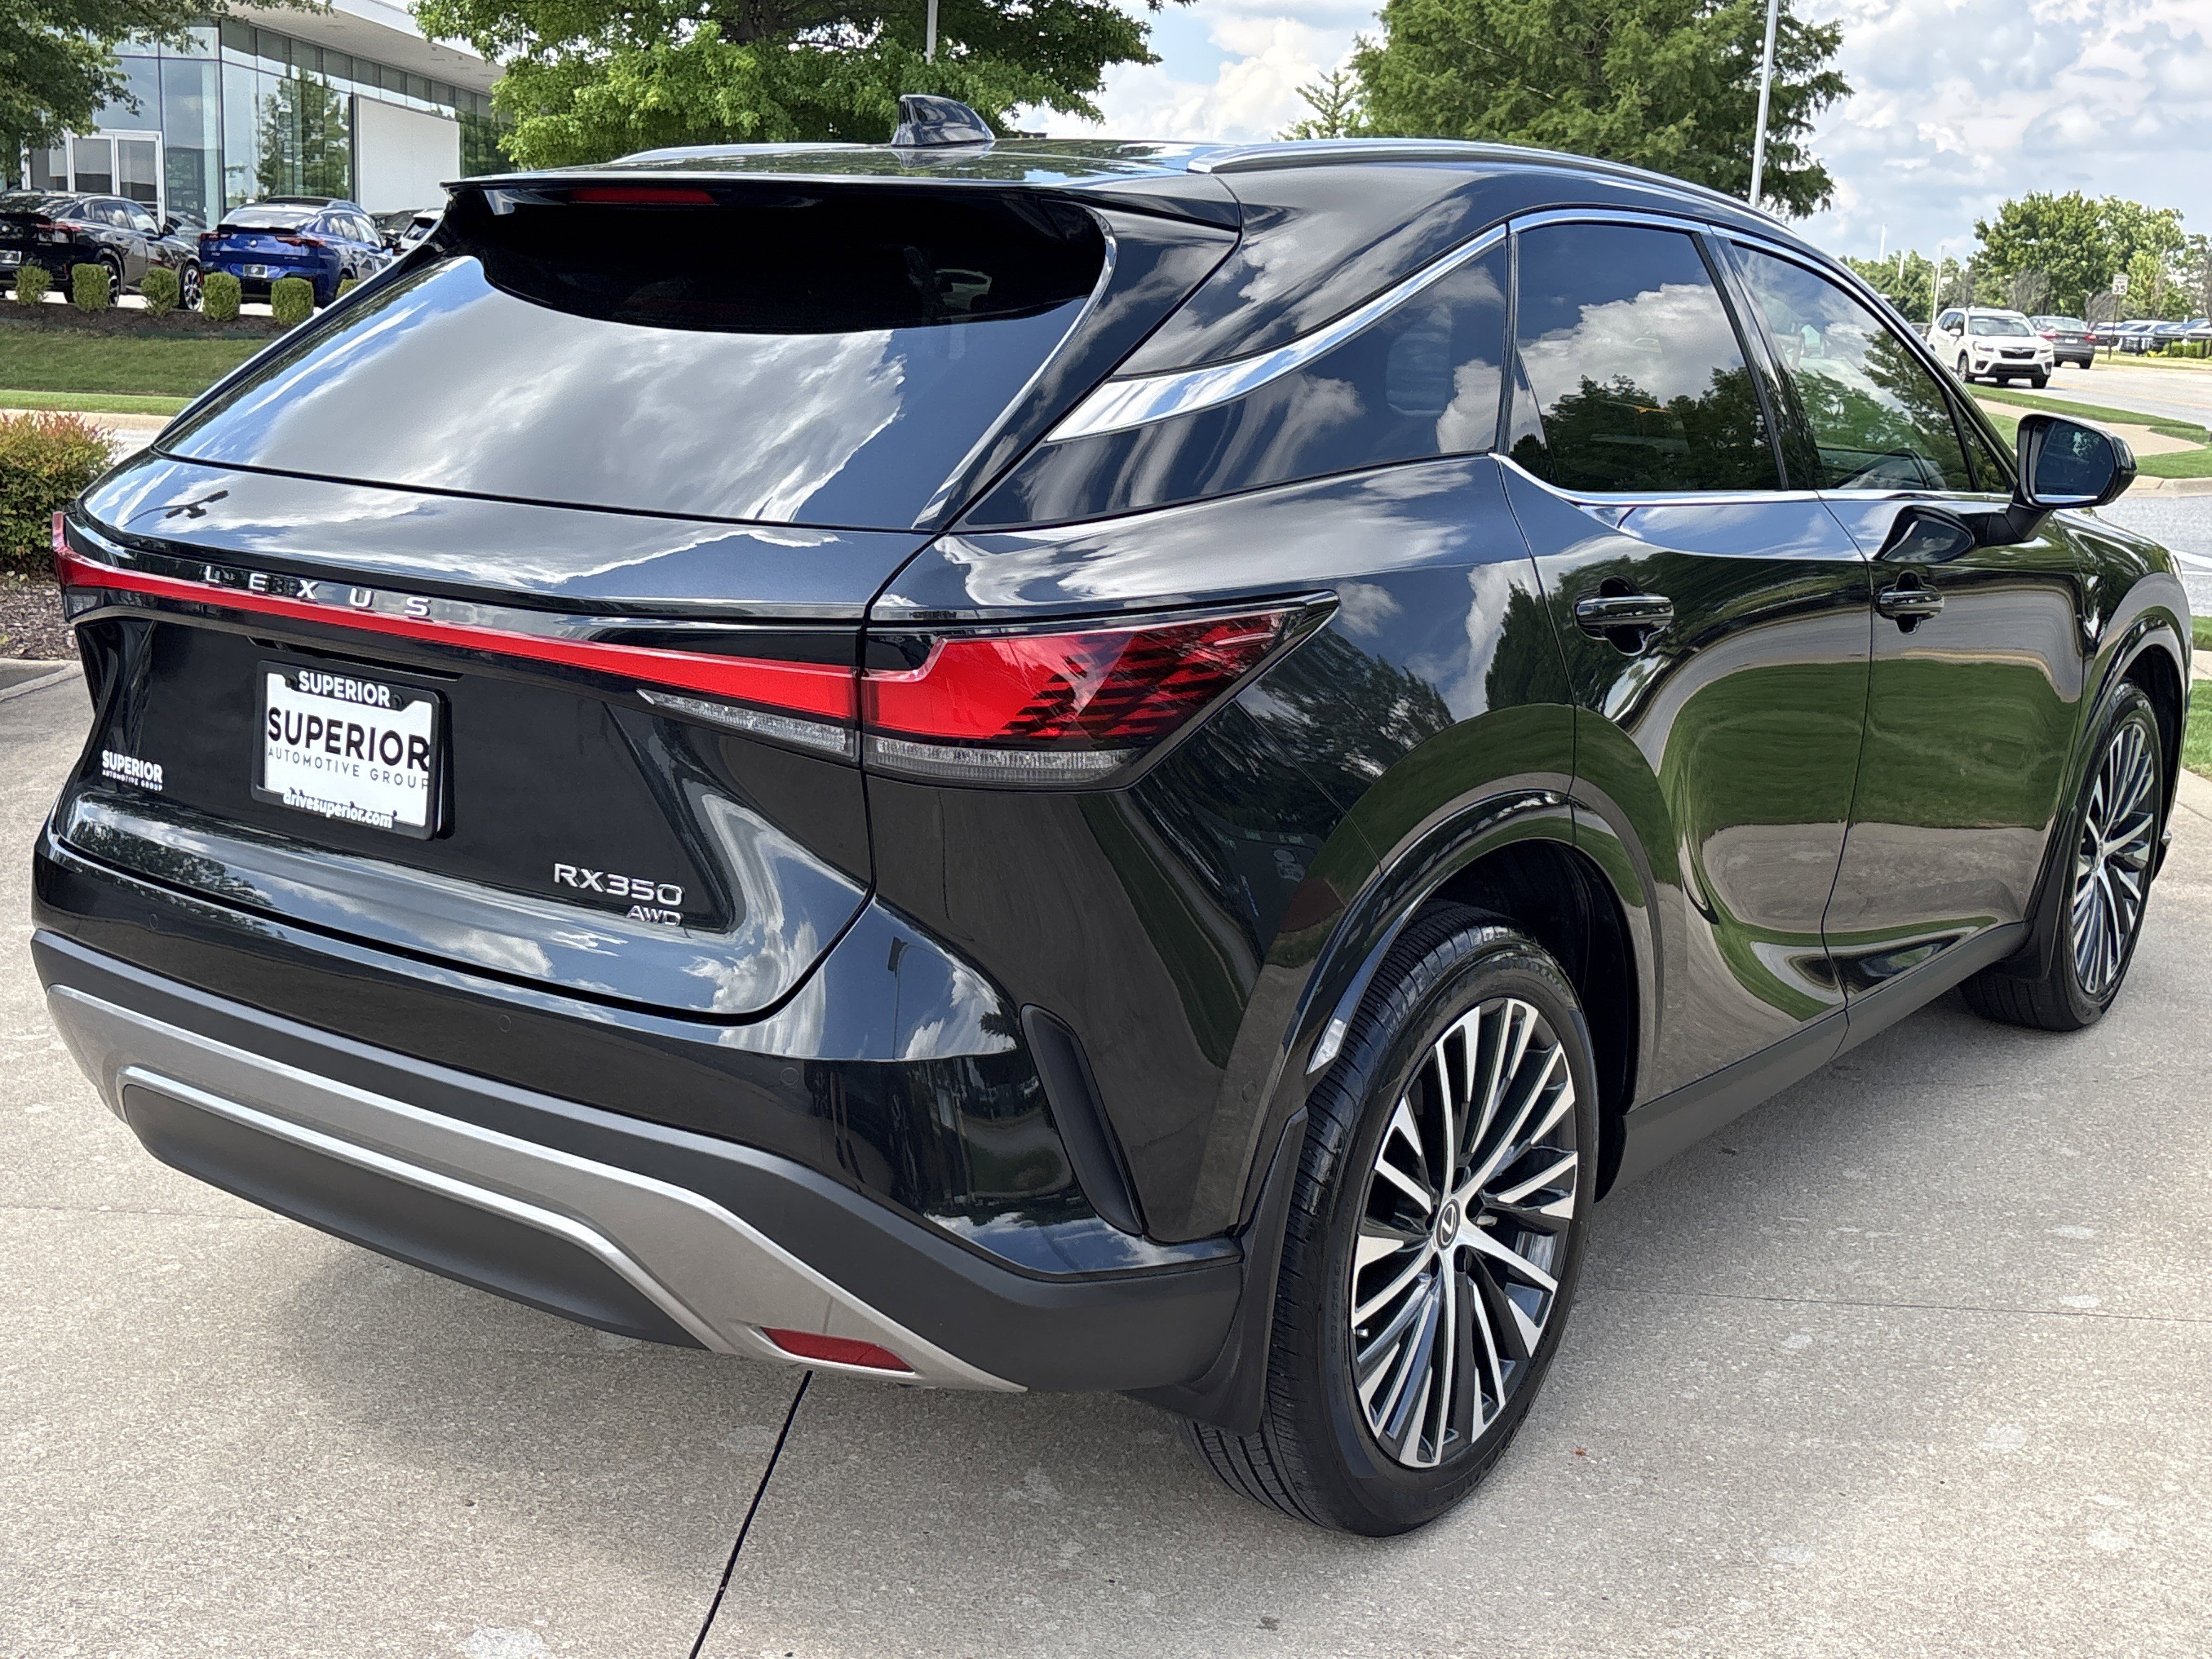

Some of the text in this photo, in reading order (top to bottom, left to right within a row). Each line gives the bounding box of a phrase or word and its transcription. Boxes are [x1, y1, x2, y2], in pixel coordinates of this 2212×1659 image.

[2114, 285, 2126, 293] 35
[205, 565, 431, 616] LEXUS
[298, 670, 390, 708] SUPERIOR
[268, 707, 430, 772] SUPERIOR
[102, 749, 163, 784] SUPERIOR
[268, 746, 429, 790] AUTOMOTIVE GROUP
[283, 790, 395, 828] drivesuperior.com
[554, 863, 684, 906] RX350
[625, 905, 684, 926] AWD
